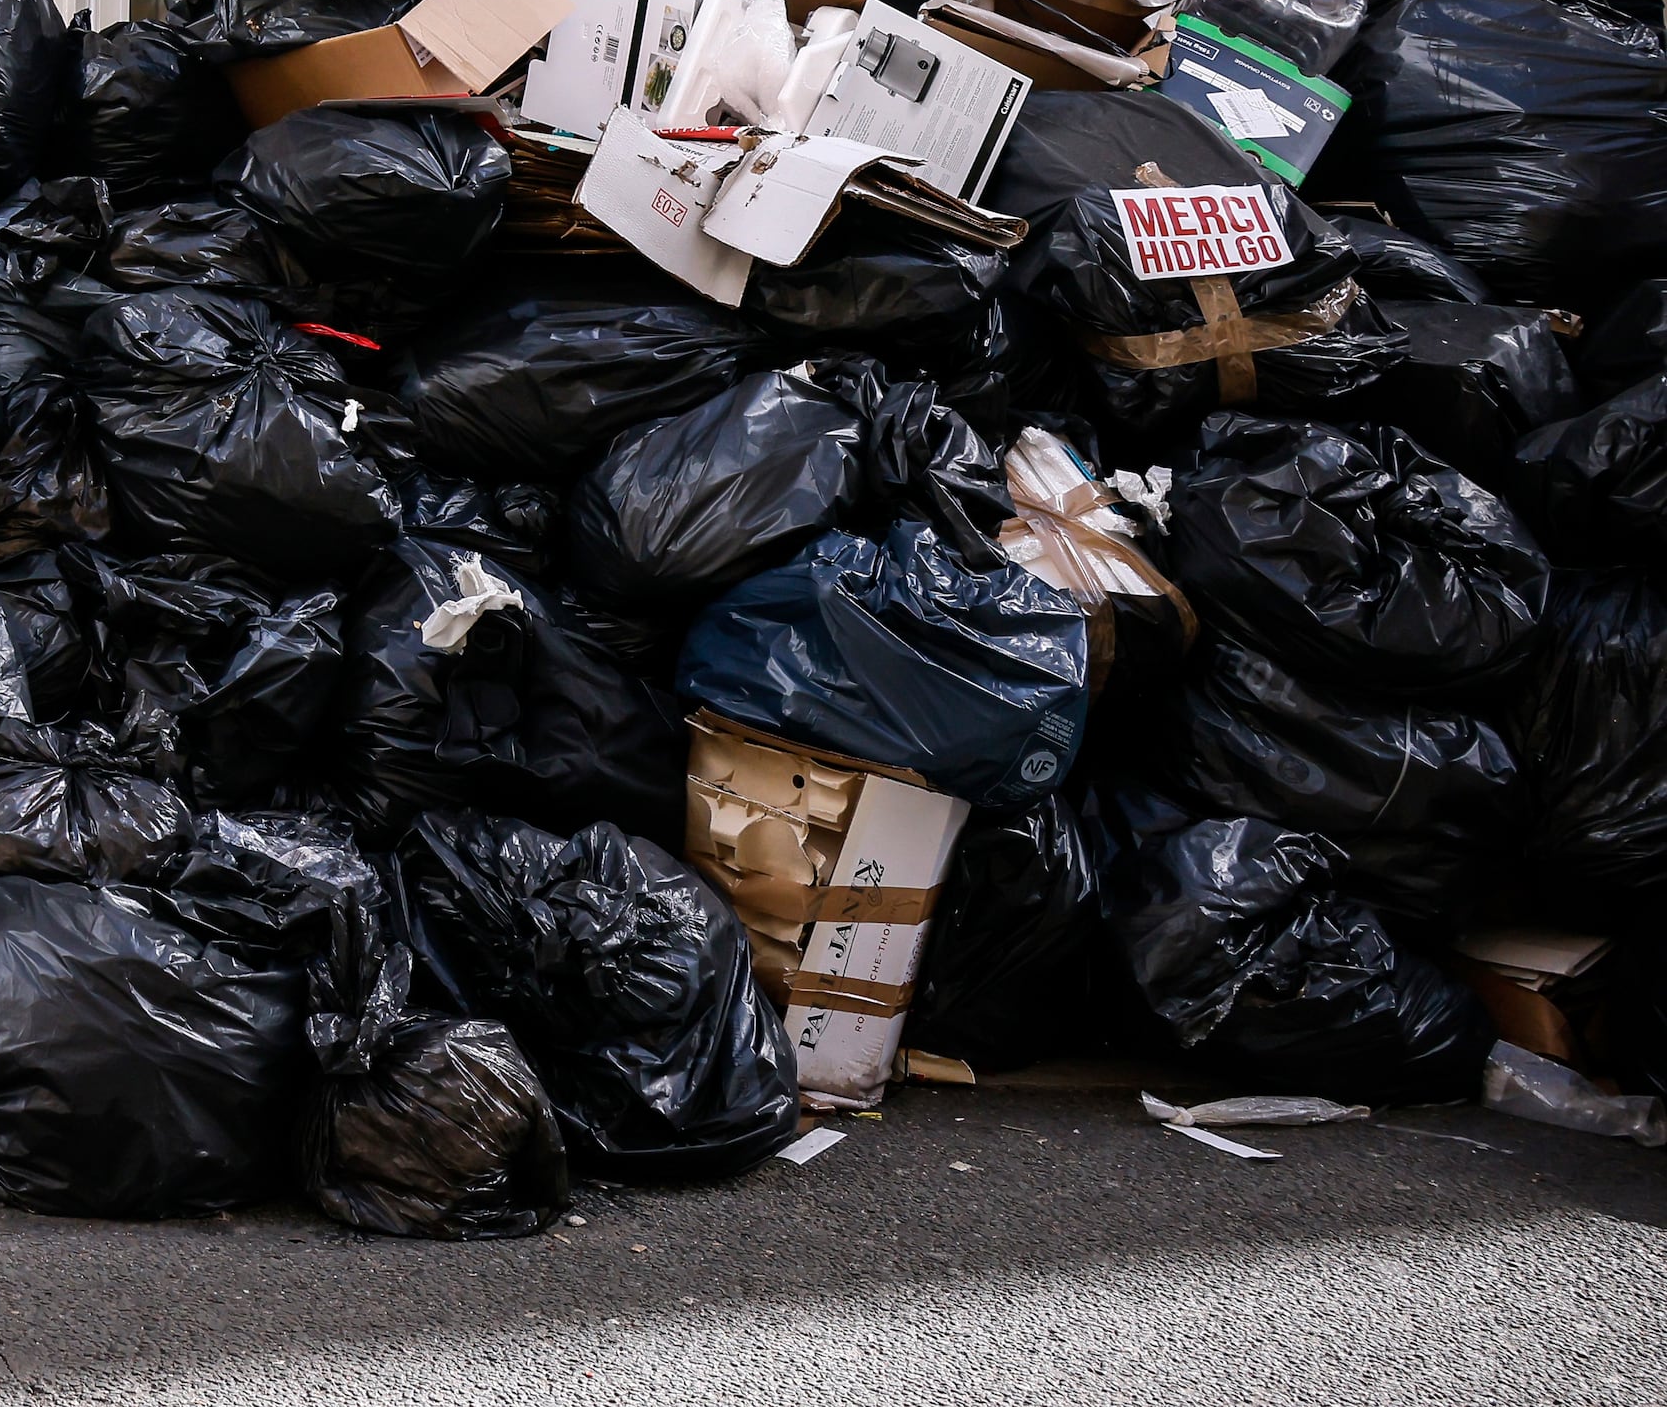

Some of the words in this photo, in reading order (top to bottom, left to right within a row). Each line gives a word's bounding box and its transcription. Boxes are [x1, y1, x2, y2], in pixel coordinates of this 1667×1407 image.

[1000, 81, 1020, 116] Cuisinart
[1122, 196, 1268, 238] MERCI
[1136, 234, 1283, 275] HIDALGO
